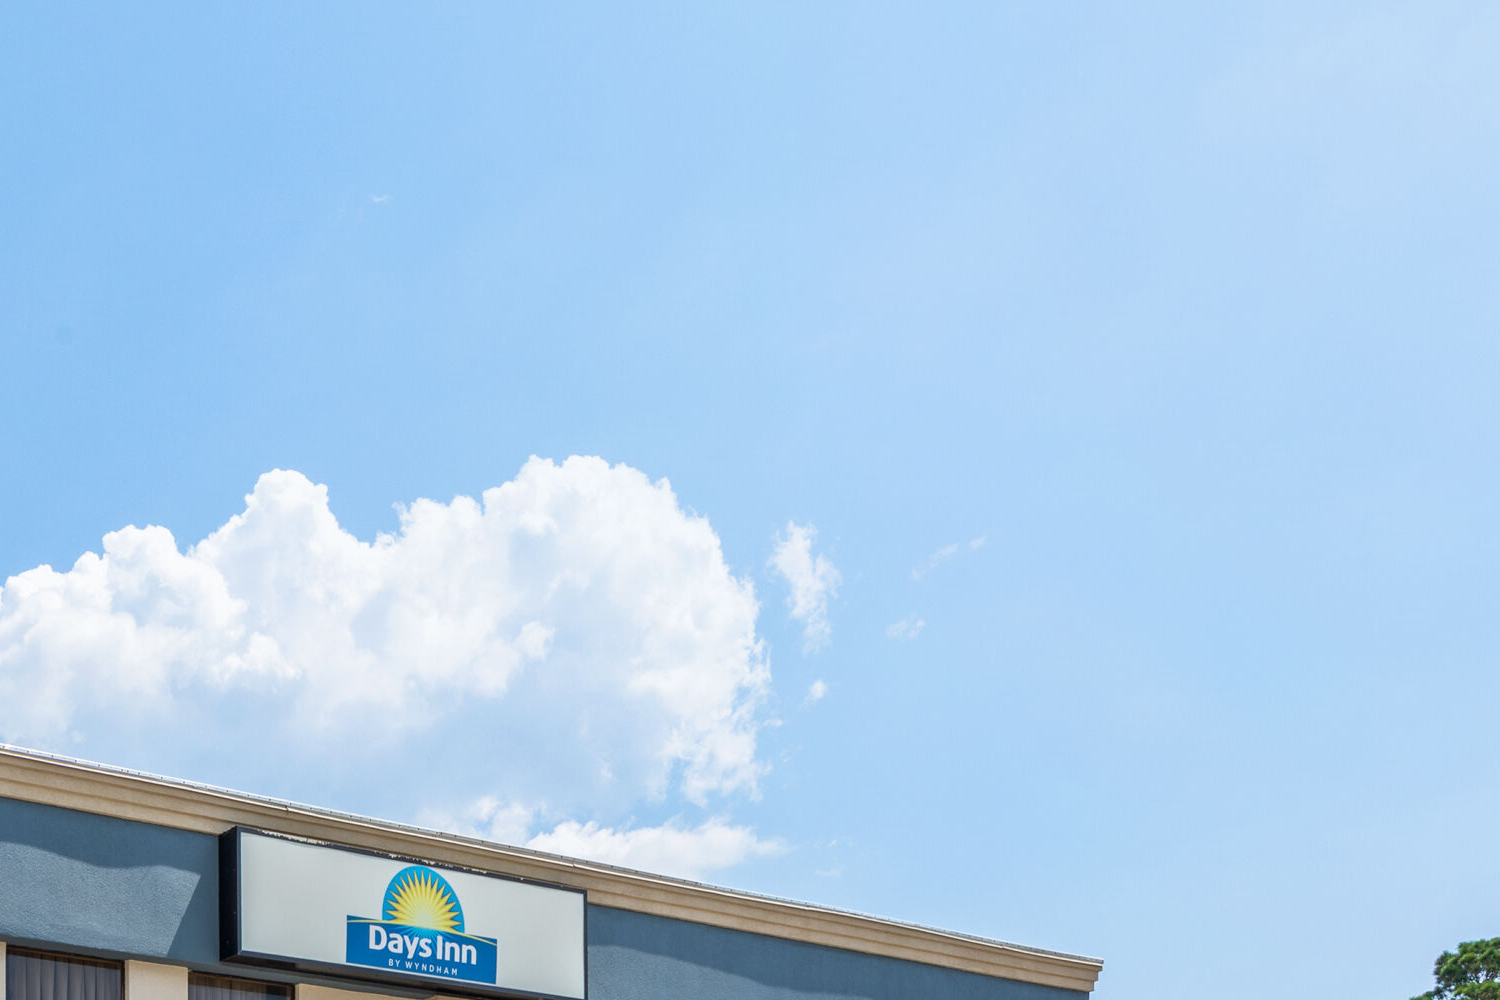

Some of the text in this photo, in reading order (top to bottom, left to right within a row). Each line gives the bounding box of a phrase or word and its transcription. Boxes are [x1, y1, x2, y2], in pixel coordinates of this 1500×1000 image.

[369, 924, 477, 965] Days Inn
[388, 958, 458, 976] BY WYNDHAM
